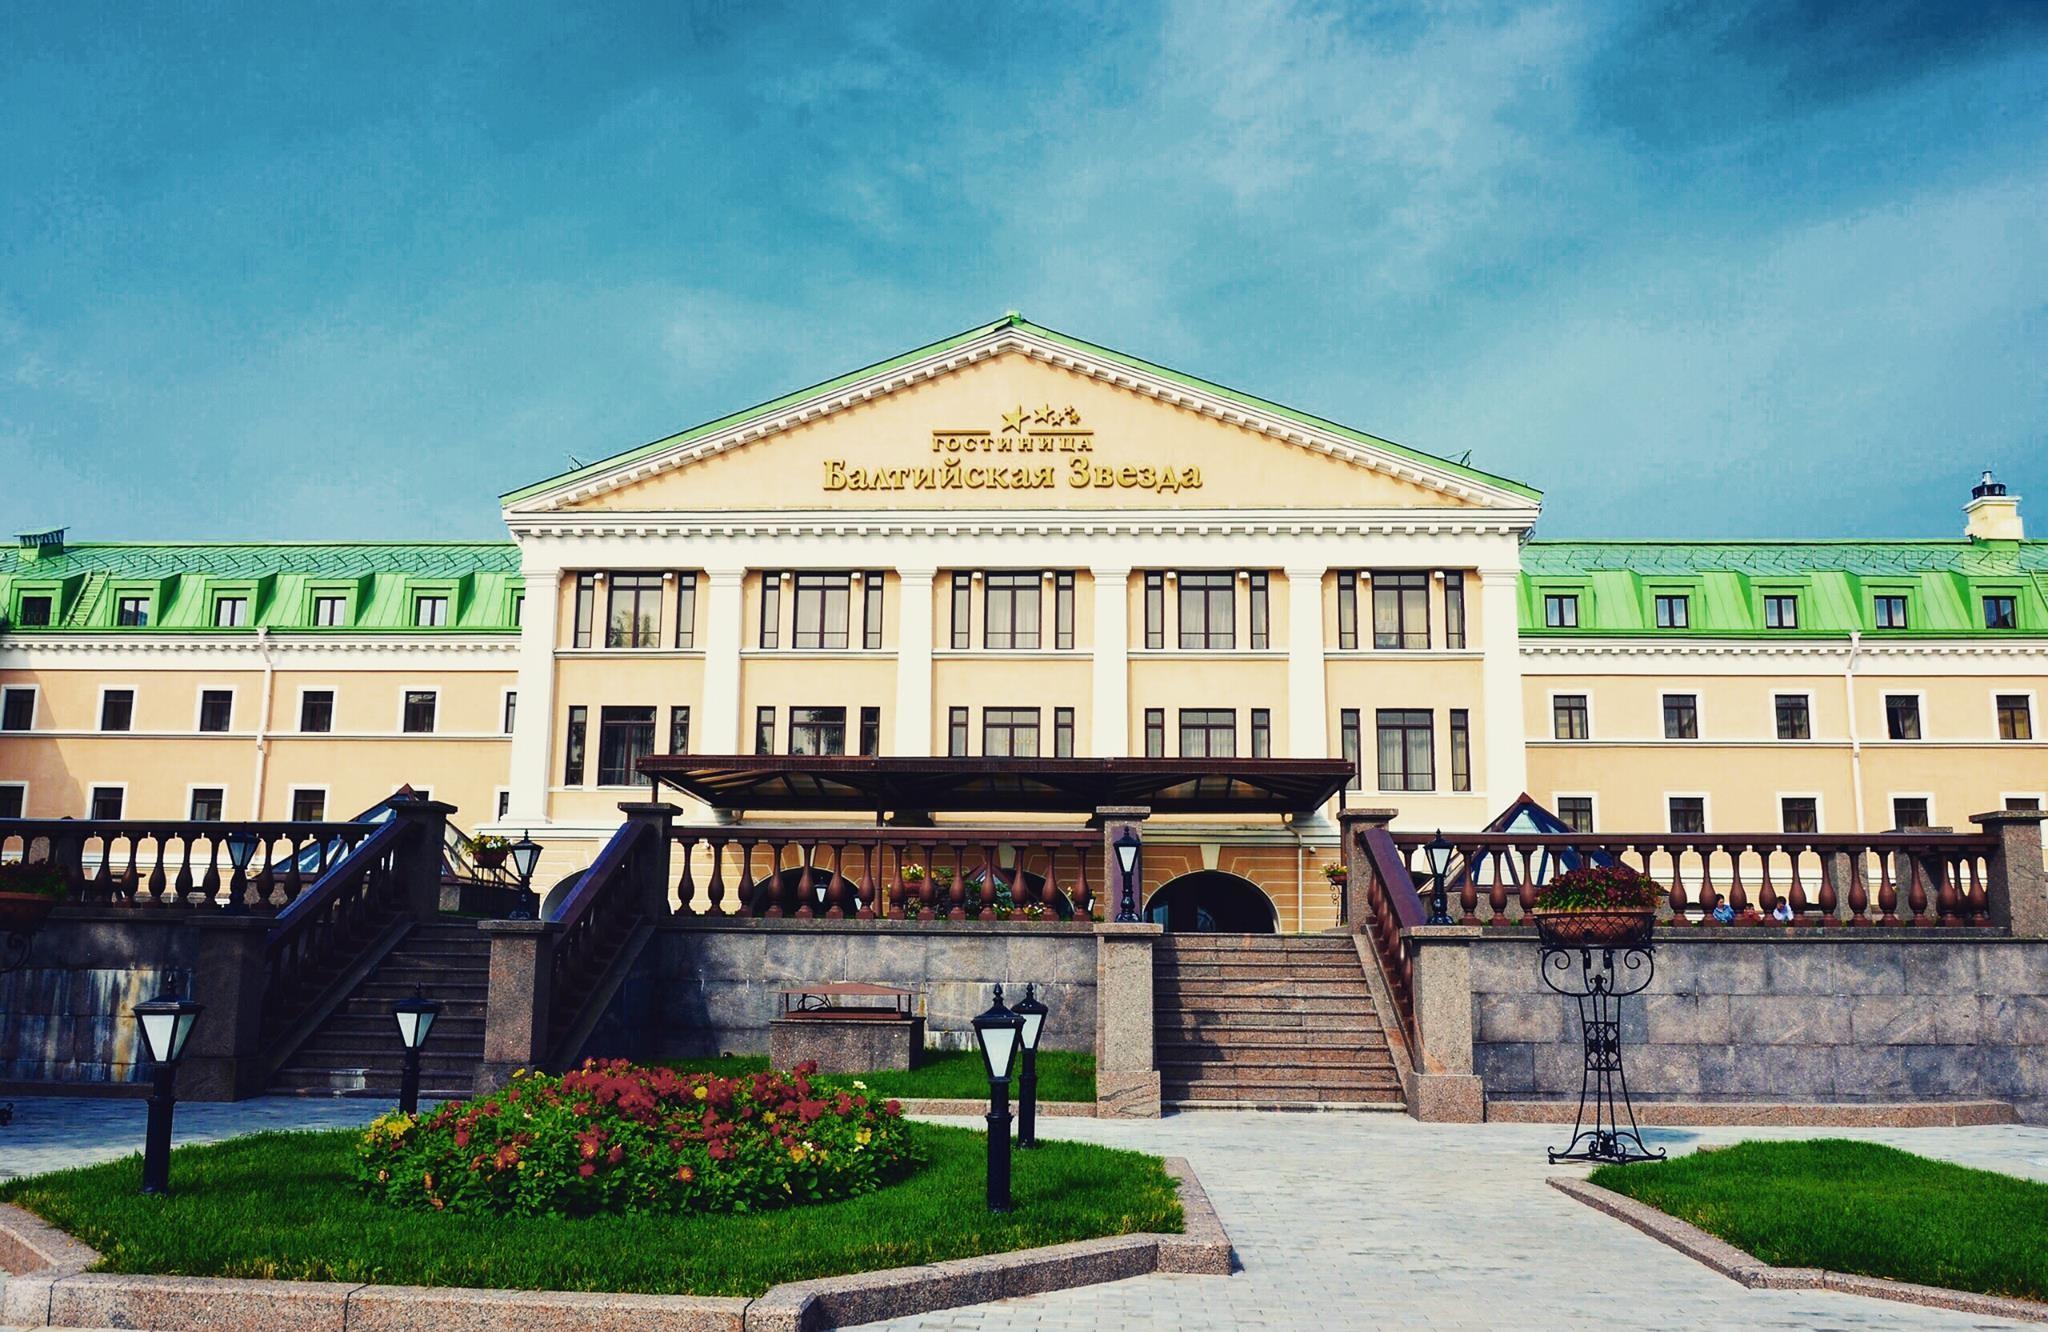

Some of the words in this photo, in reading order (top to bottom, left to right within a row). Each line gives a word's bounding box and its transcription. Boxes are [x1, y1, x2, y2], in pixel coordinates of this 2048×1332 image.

[931, 436, 1093, 452] ГОСТИНИЦА
[823, 457, 1055, 491] Балтийская
[1067, 455, 1203, 494] Звезда
